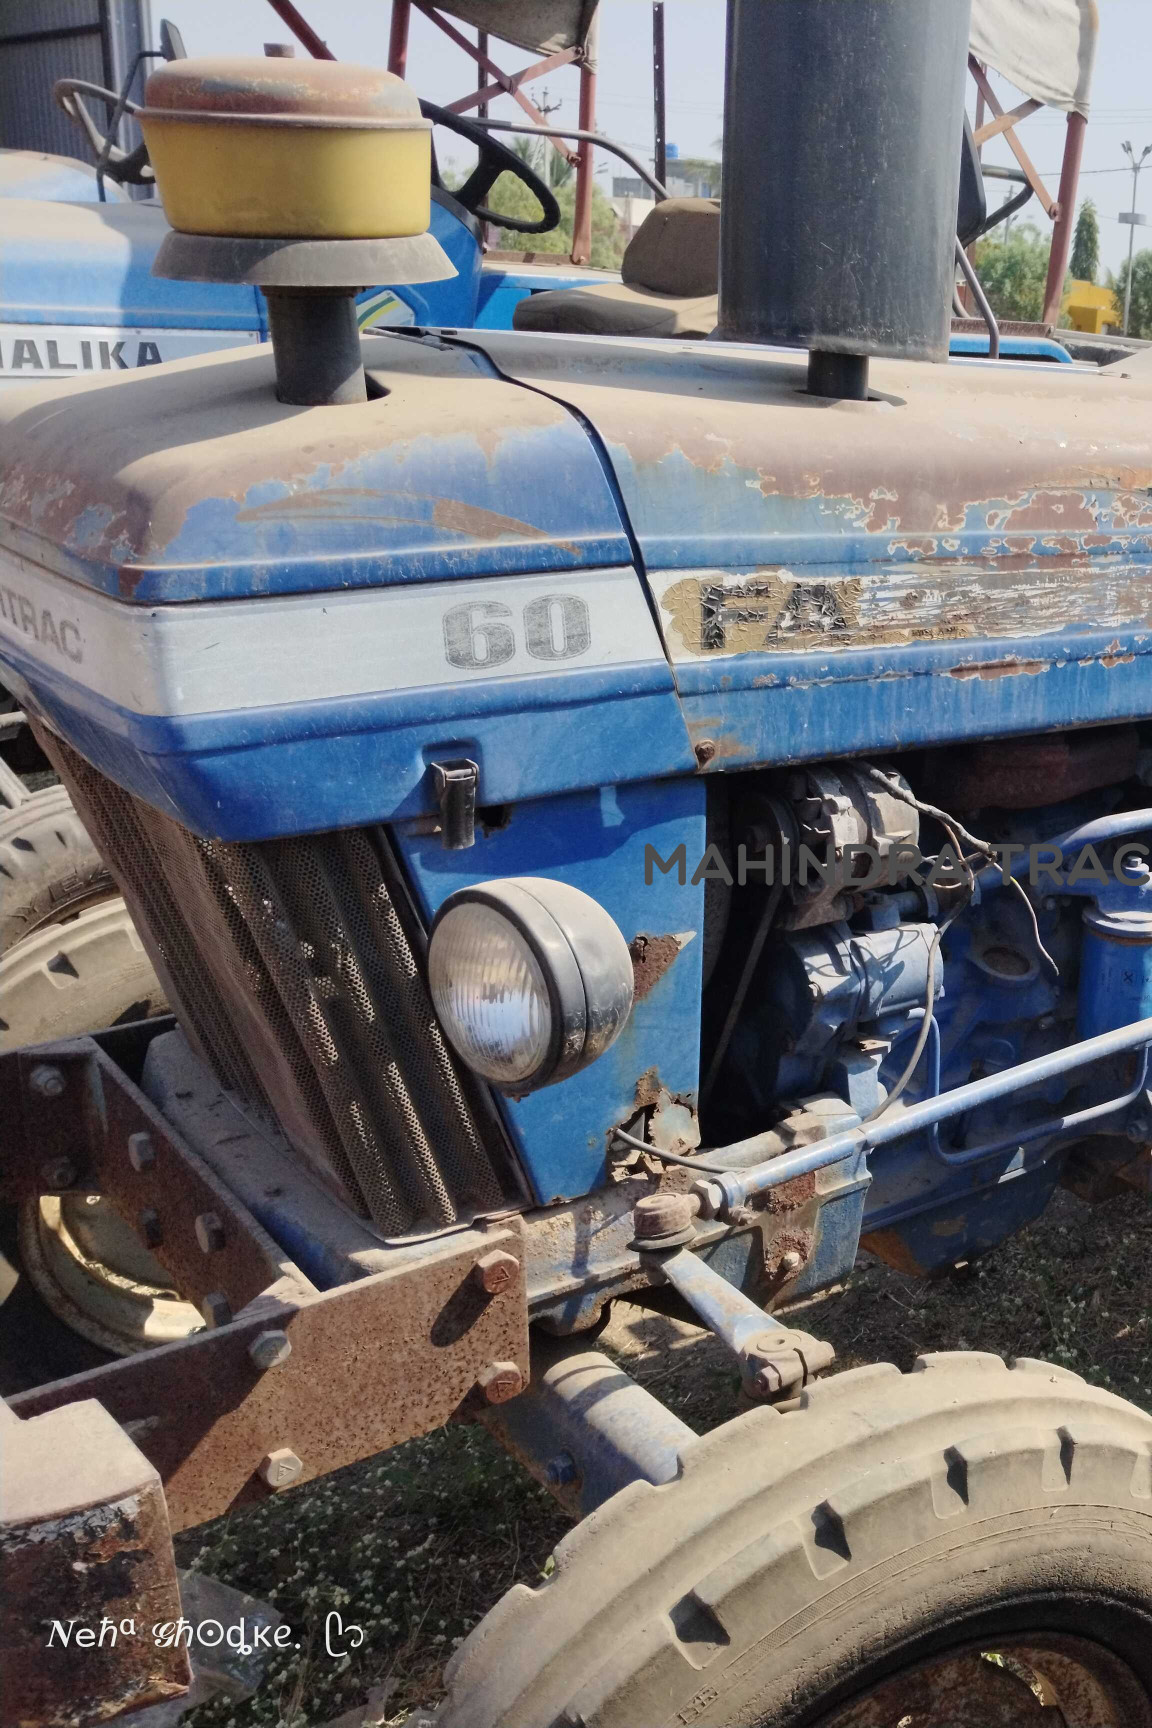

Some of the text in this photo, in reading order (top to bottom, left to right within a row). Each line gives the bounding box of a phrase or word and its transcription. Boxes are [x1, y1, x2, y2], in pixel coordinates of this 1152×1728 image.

[0, 339, 163, 370] ALIKA
[0, 584, 83, 665] TRAC
[442, 594, 592, 670] 60
